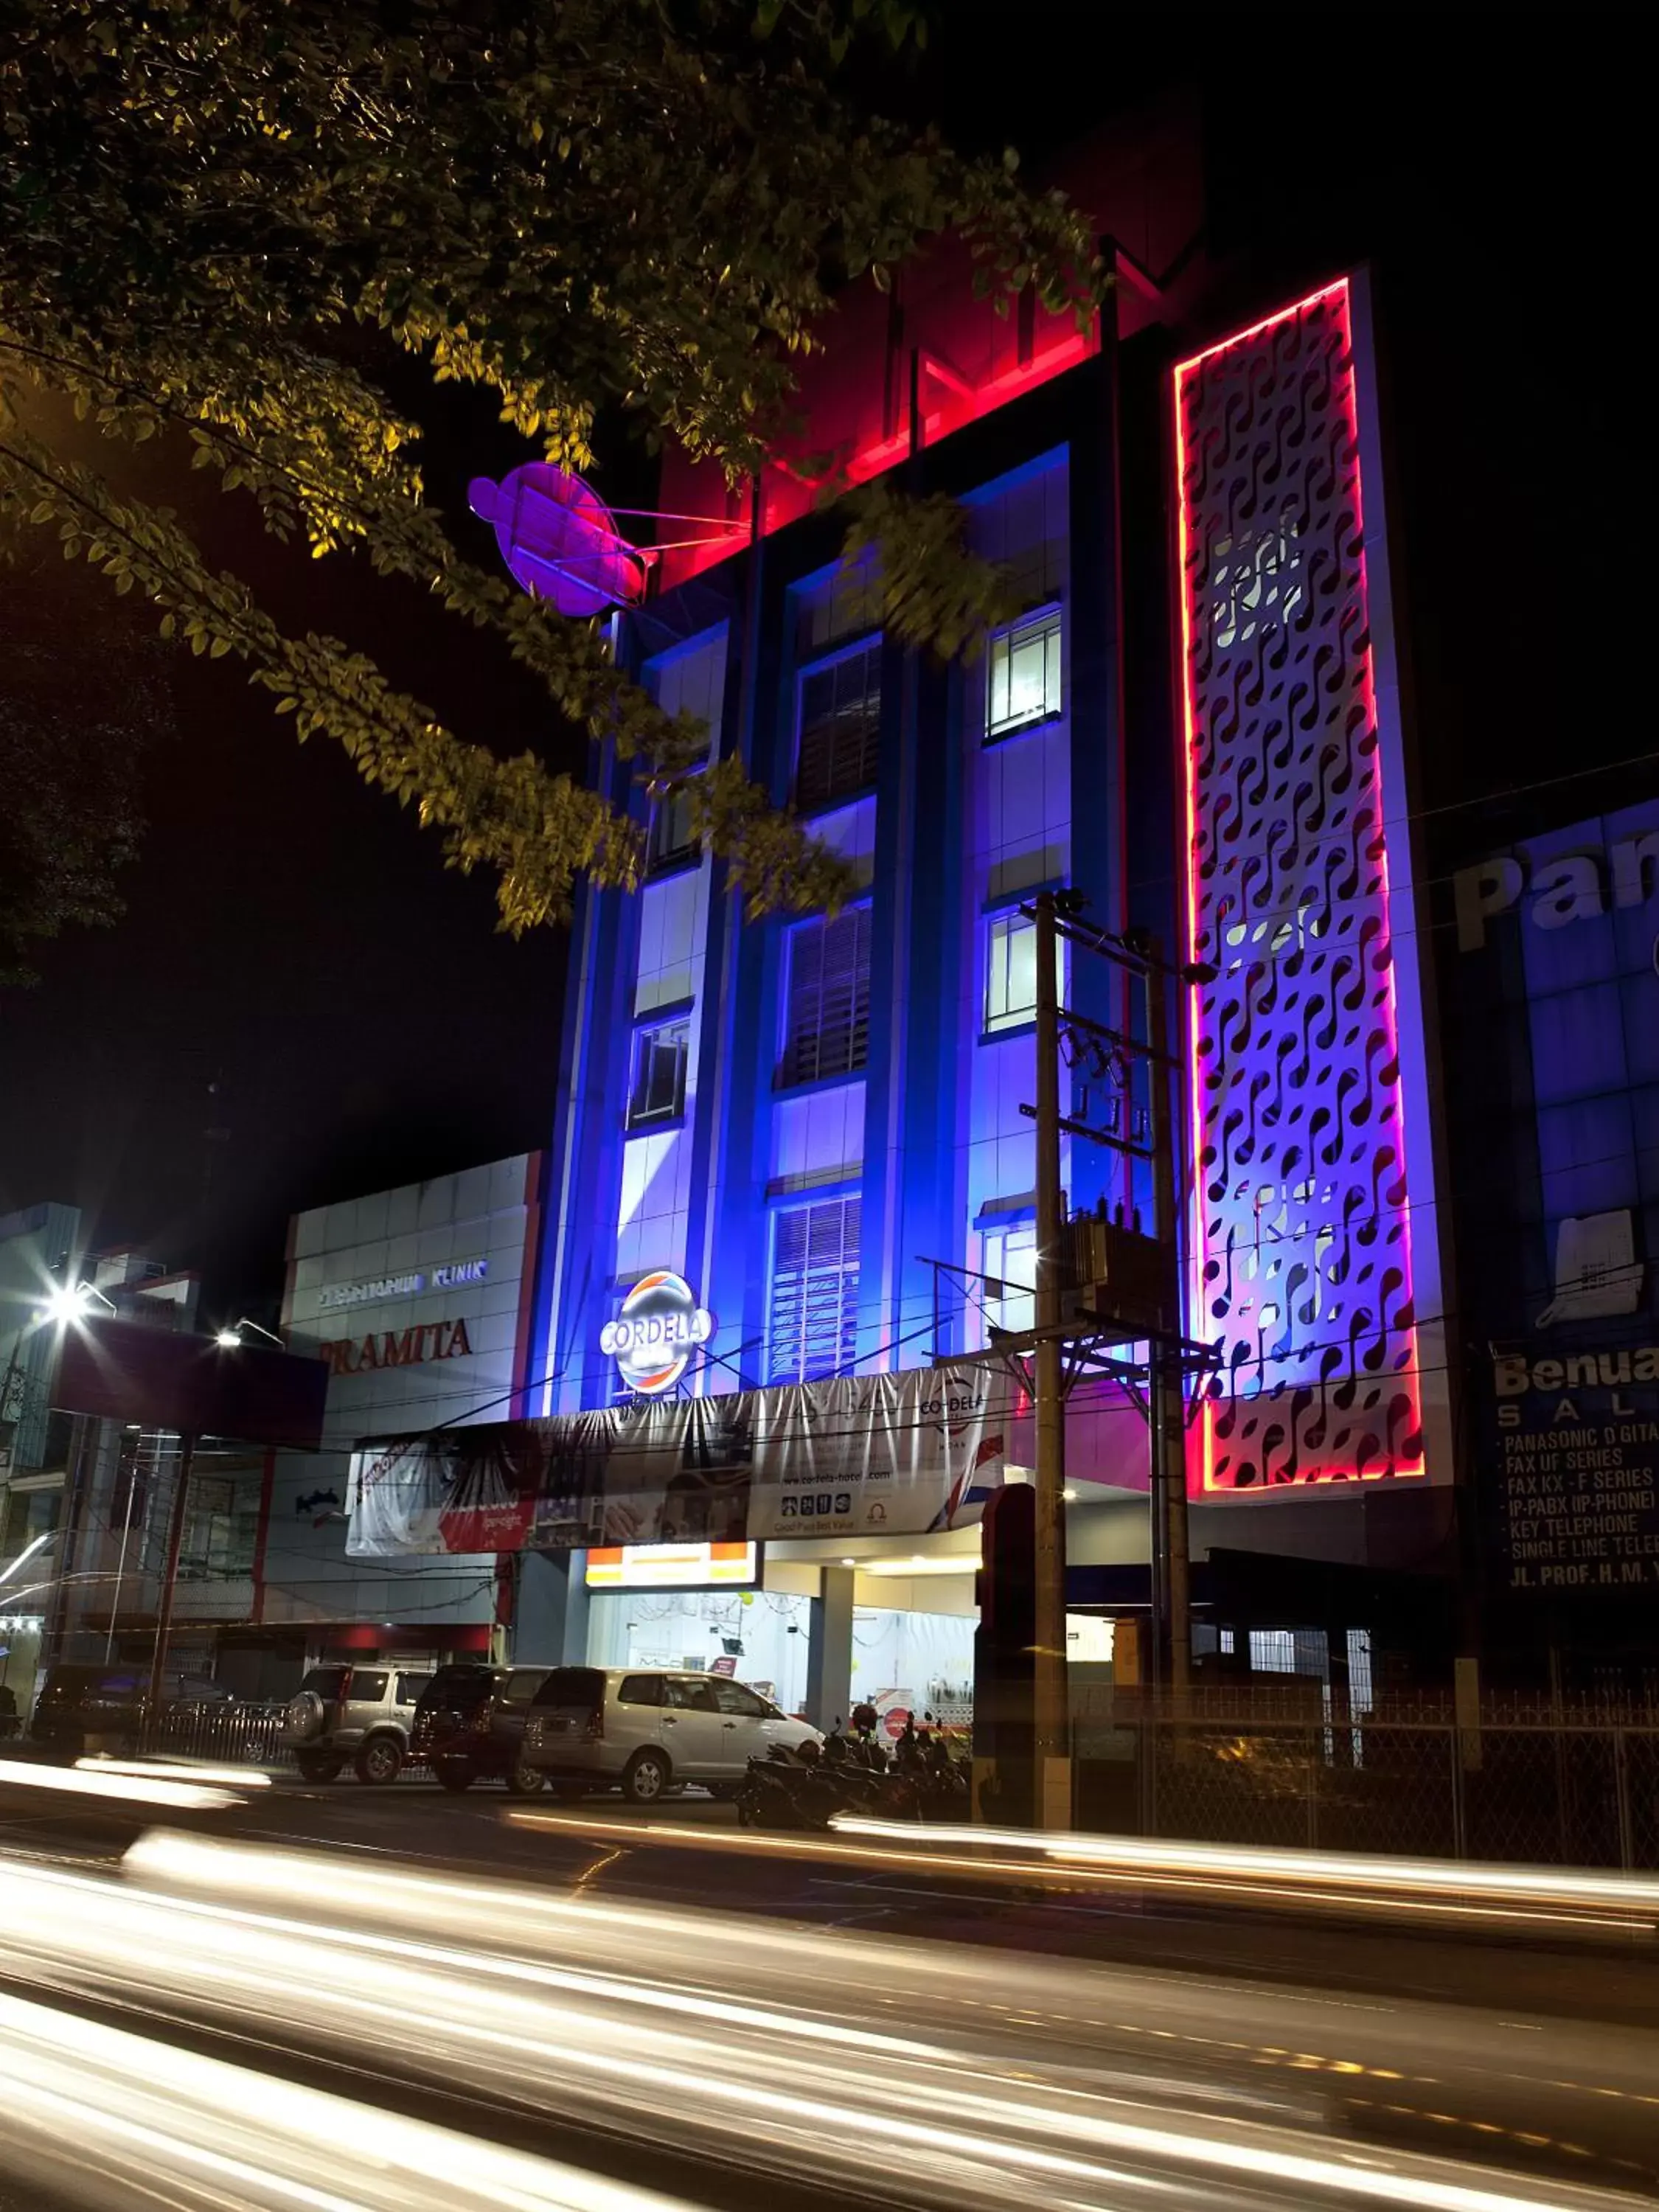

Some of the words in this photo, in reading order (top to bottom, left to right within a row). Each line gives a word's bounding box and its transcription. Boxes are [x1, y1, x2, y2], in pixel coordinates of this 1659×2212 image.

[431, 1260, 489, 1287] KLINIK
[603, 1312, 707, 1350] CORDELA
[1494, 1347, 1659, 1397] Benua
[920, 1394, 983, 1415] CODELA
[1505, 1427, 1598, 1454] PANASONIC
[1604, 1422, 1659, 1445] DGITA
[1506, 1455, 1536, 1474] FAX
[1540, 1453, 1561, 1472] UF
[1566, 1447, 1623, 1470] SERIES
[1507, 1475, 1537, 1495] FAX
[1542, 1474, 1563, 1493] KX
[1593, 1467, 1654, 1489] SERIES
[1509, 1496, 1568, 1517] IP-PABX
[1571, 1490, 1655, 1513] (IP-PHONE)
[1510, 1520, 1540, 1539] KEY
[1545, 1514, 1638, 1537] TELEPHONE
[1512, 1540, 1567, 1559] SINGLE
[1572, 1537, 1607, 1557] LINE
